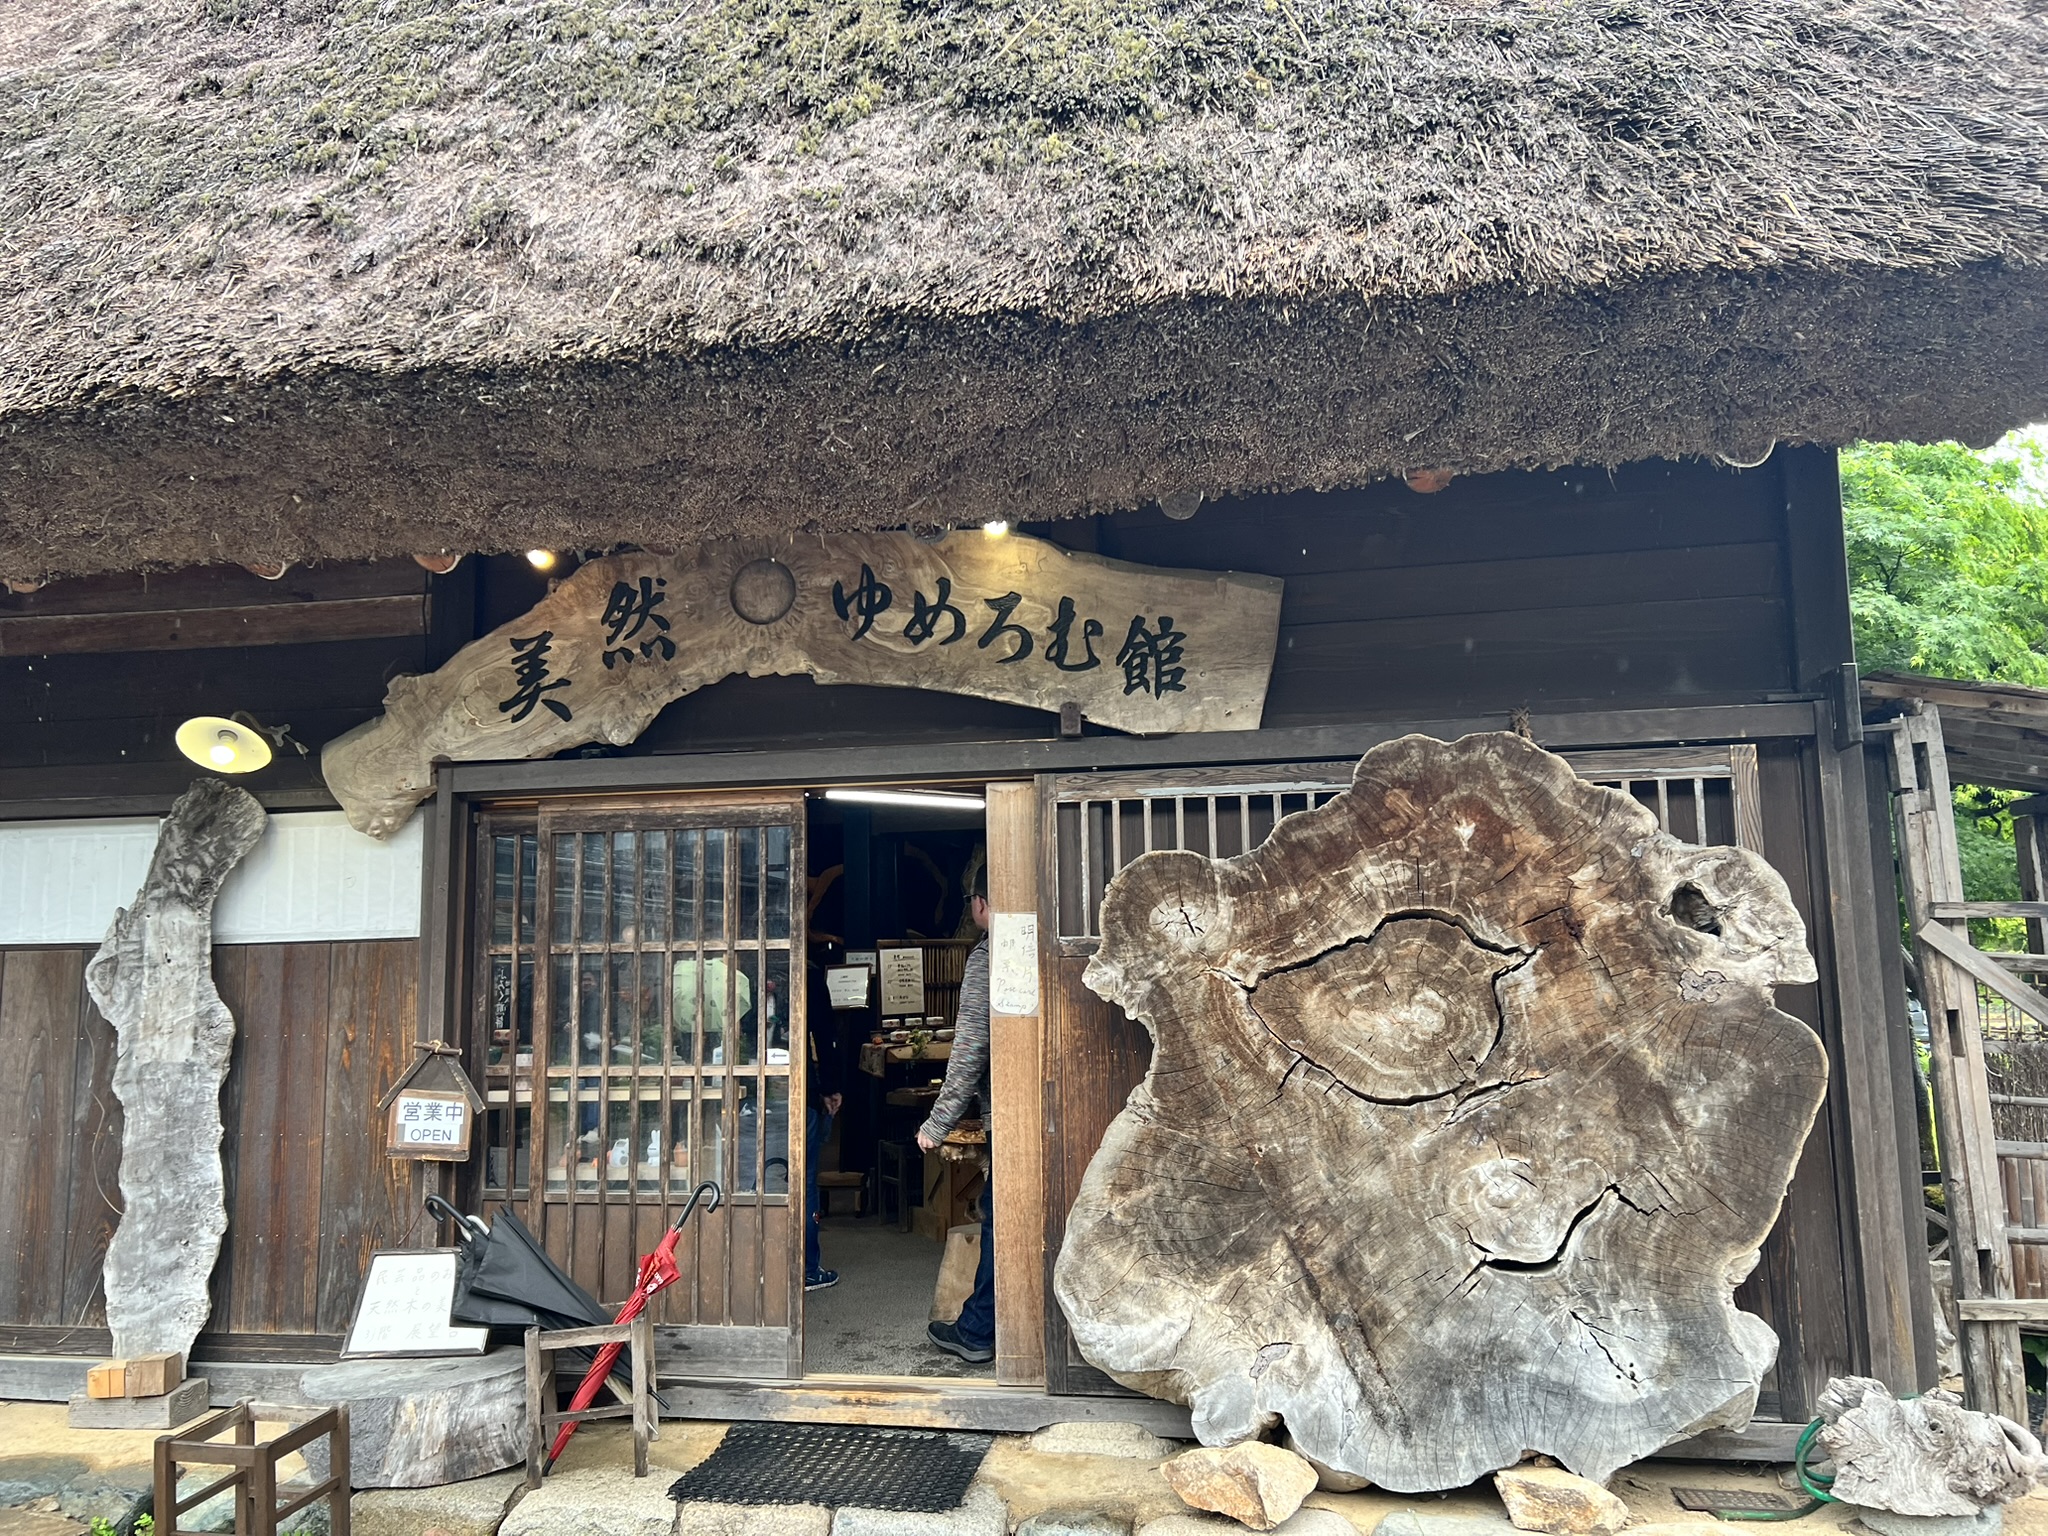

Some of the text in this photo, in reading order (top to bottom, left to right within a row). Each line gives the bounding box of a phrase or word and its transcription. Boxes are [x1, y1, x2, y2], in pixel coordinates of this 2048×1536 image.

[499, 563, 1187, 723] 美然 ゆめろむ館
[403, 1101, 463, 1122] 営業中
[410, 1128, 452, 1142] OPEN
